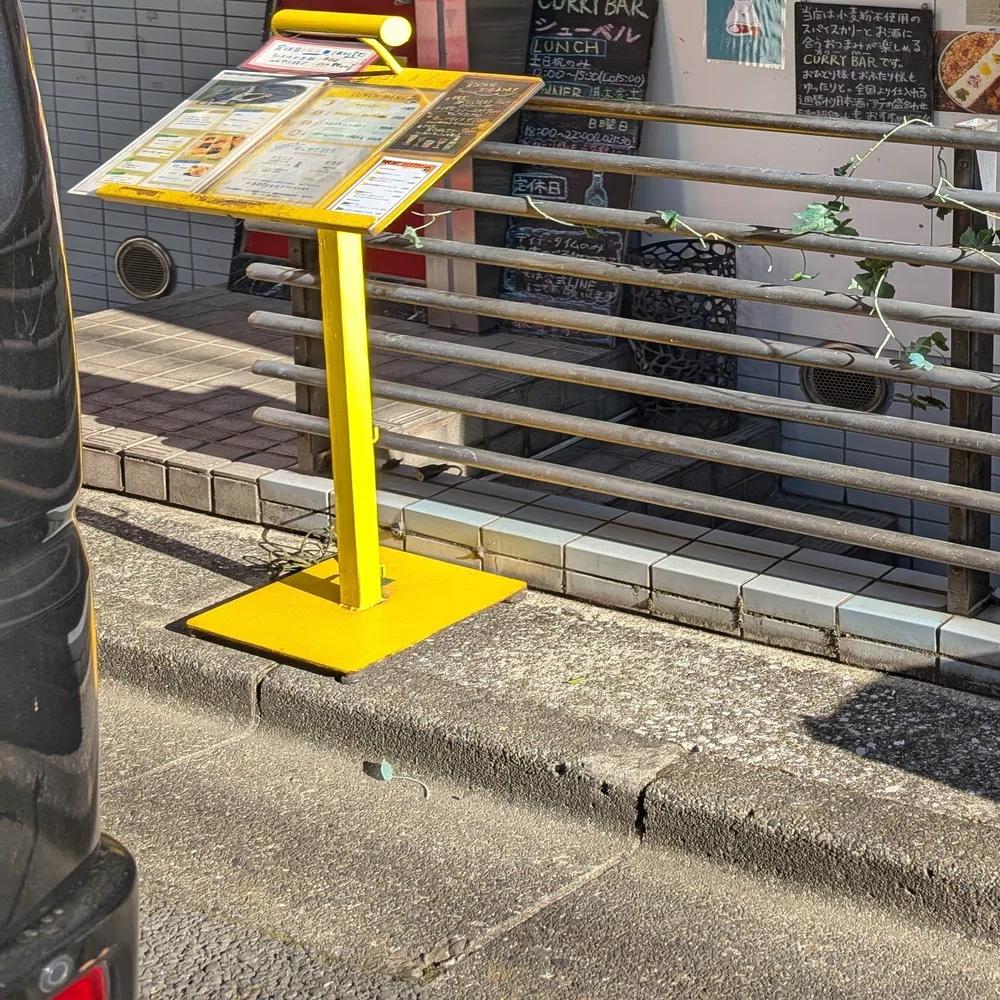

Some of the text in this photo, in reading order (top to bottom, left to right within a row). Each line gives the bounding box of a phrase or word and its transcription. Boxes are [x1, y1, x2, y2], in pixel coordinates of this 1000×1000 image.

[534, 17, 642, 43] シューベル
[533, 39, 599, 55] LUNCH
[803, 54, 848, 67] CURRY
[851, 56, 878, 68] BAR
[514, 177, 561, 195] 定休日
